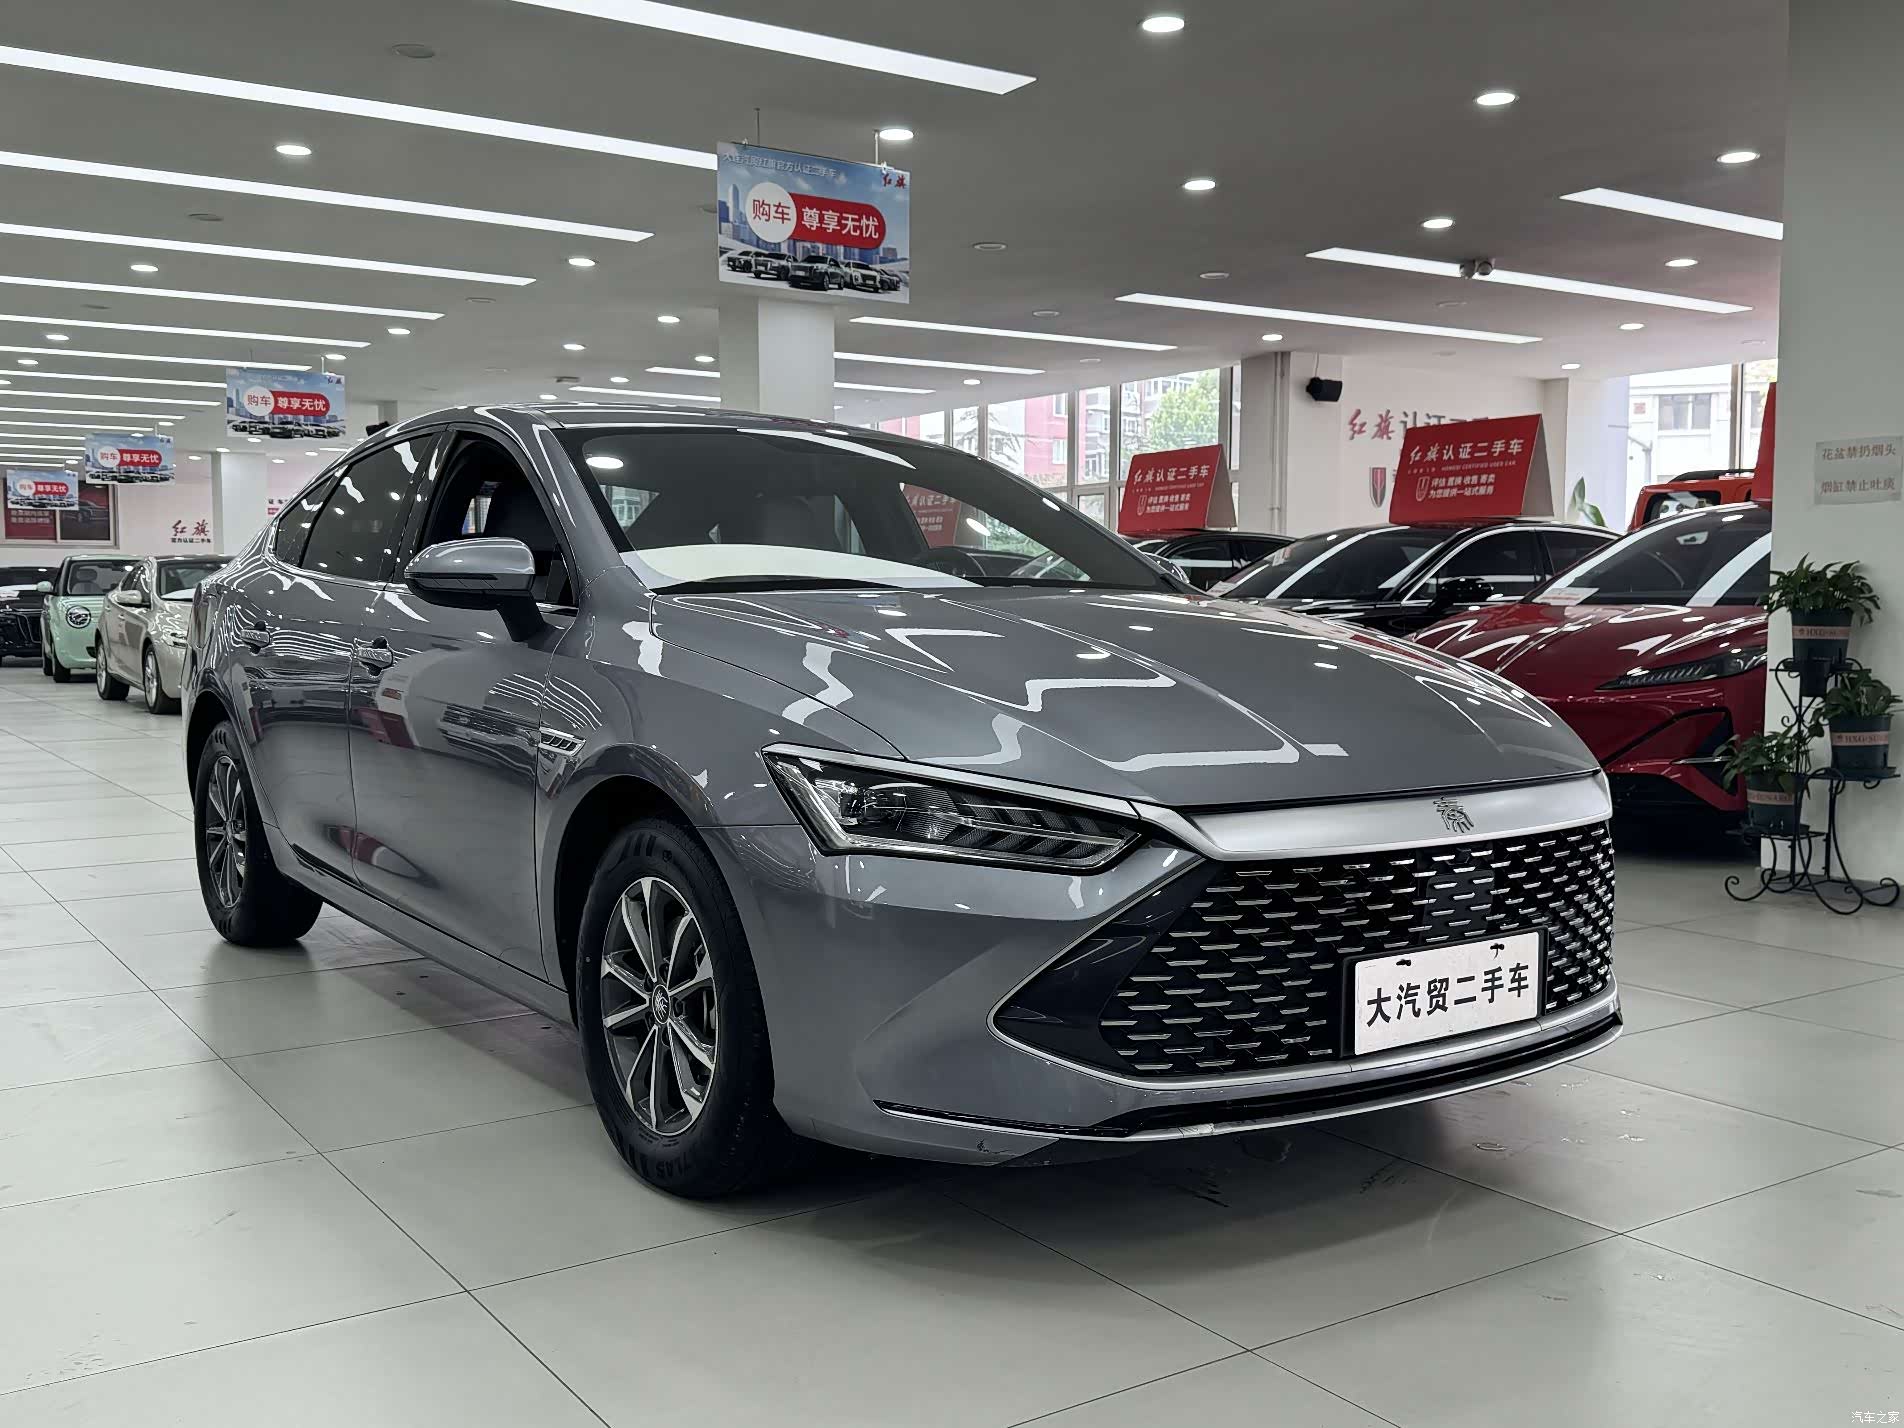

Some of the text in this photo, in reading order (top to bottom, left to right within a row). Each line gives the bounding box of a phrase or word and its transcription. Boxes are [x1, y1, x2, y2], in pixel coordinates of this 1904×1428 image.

[752, 199, 879, 239] 购车 尊享无忧
[248, 394, 326, 411] 购车 尊享无忧
[1409, 439, 1524, 464] 红旗认证二手车
[172, 519, 210, 536] 红旗
[1366, 962, 1529, 1027] 大汽贸二手车
